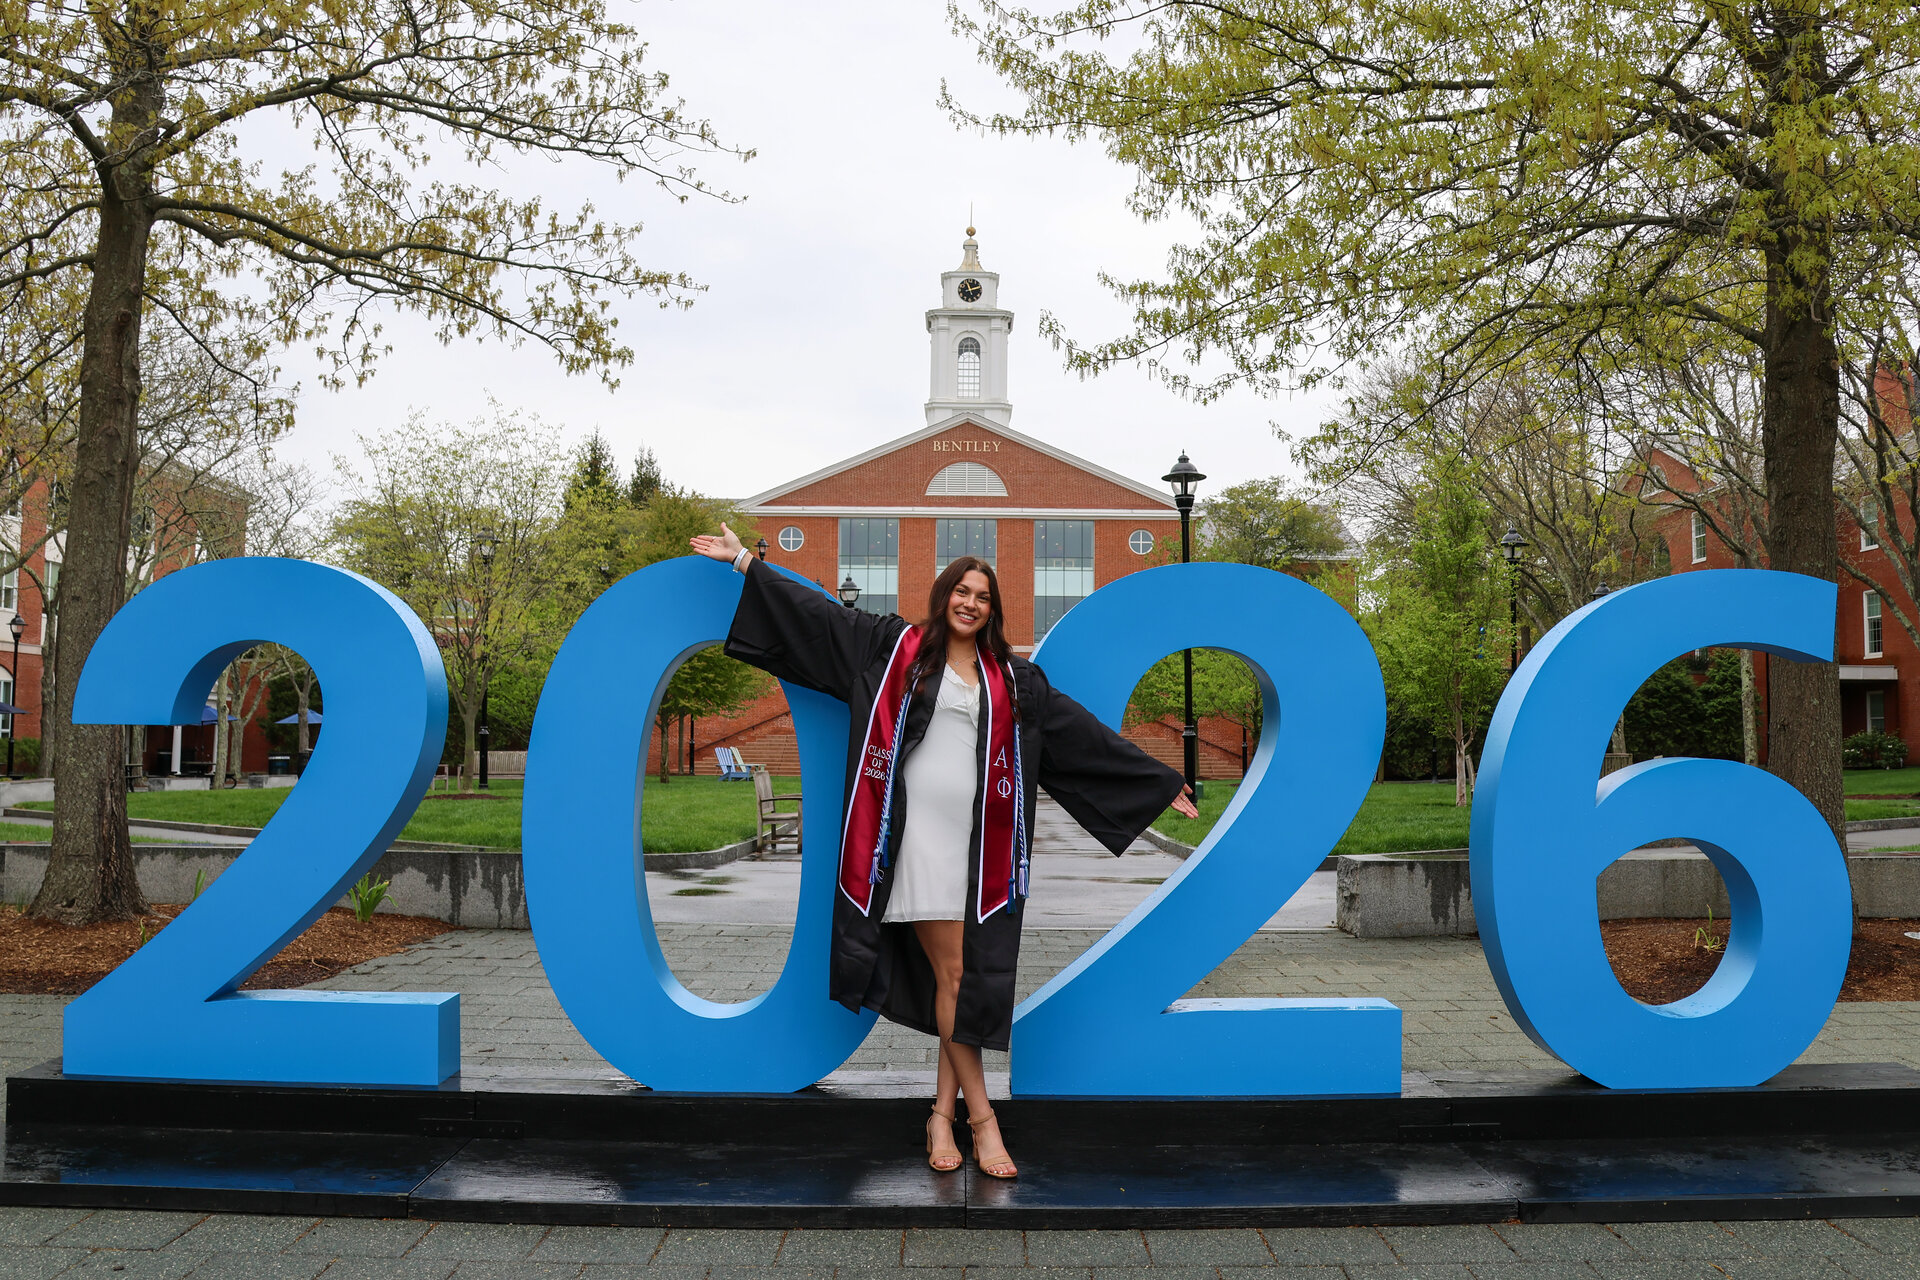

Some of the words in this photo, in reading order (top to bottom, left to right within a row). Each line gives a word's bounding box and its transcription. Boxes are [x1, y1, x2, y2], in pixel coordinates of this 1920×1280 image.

[933, 440, 1001, 452] BENTLEY
[868, 745, 891, 760] CLASS
[872, 757, 883, 768] OF
[864, 767, 885, 780] 2026
[63, 557, 1850, 1096] 2026
